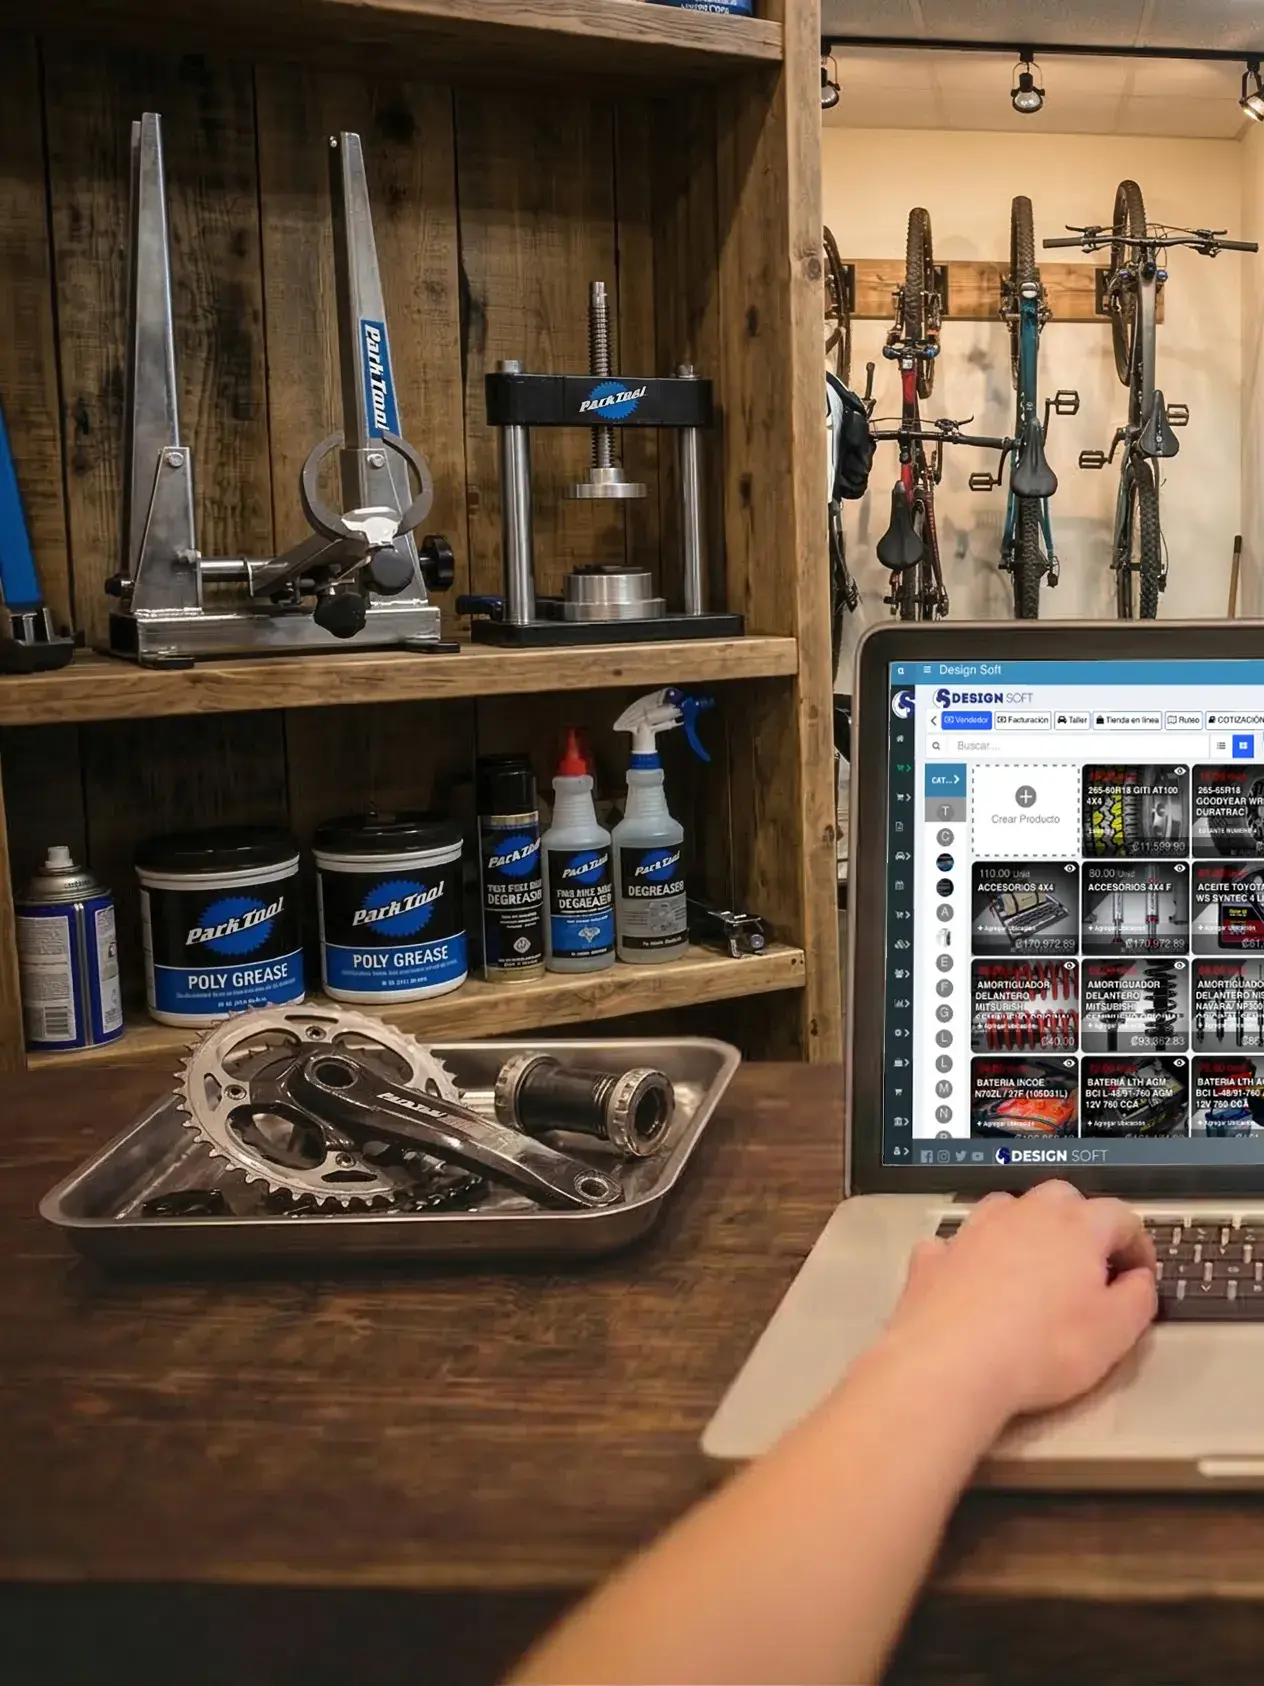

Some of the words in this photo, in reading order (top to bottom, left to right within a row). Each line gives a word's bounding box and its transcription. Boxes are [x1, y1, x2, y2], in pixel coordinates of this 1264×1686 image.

[939, 664, 977, 677] Design
[980, 664, 1002, 675] Soft
[952, 692, 1004, 704] DESIGN
[1005, 692, 1034, 704] SOFT
[955, 716, 989, 724] Vendedor
[1008, 715, 1049, 724] Facturación
[1069, 716, 1087, 724] Taller
[1106, 716, 1130, 724] Tienda
[957, 741, 990, 751] Buscar
[1088, 786, 1132, 794] 265-60R18
[1152, 786, 1178, 794] AT100
[1196, 797, 1247, 805] GOODYEAR
[1196, 808, 1245, 816] DURATRAC
[991, 814, 1017, 824] Crear
[1019, 814, 1061, 824] Producto
[979, 869, 1010, 878] 110.00
[1088, 869, 1115, 878] 80.00
[977, 883, 1036, 892] ACCESORIOS
[1037, 883, 1054, 892] 4X4
[1088, 883, 1147, 892] ACCESORIOS
[1148, 883, 1165, 892] 4X4
[1198, 883, 1229, 892] ACEITE
[1196, 894, 1211, 902] WS
[1212, 894, 1248, 902] SYNTEC
[352, 901, 401, 926] Park
[185, 918, 240, 946] Park
[353, 953, 390, 969] POLY
[393, 945, 449, 966] GREASE
[188, 973, 228, 990] POLY
[232, 963, 288, 988] GREASE
[977, 981, 1050, 989] AMORTIGUADOR
[1087, 981, 1161, 989] AMORTIGUADOR
[975, 992, 1030, 1000] DELANTERO
[1086, 992, 1140, 1000] DELANTERO
[1196, 991, 1250, 999] DELANTERO
[976, 1078, 1015, 1087] BATERIA
[1016, 1078, 1045, 1087] INCOE
[1087, 1078, 1125, 1086] BATERIA
[1127, 1078, 1144, 1086] LTH
[1146, 1078, 1166, 1086] AGM
[1197, 1078, 1235, 1086] BATERIA
[1236, 1078, 1254, 1086] LTH
[974, 1090, 1002, 1098] N70ZL
[1085, 1089, 1101, 1097] BCI
[1152, 1089, 1173, 1097] AGM
[1196, 1089, 1211, 1097] BCI
[1085, 1100, 1101, 1108] 12V
[1120, 1100, 1139, 1108] CCA
[1196, 1100, 1212, 1108] 12V
[1230, 1100, 1249, 1108] CCA
[1011, 1150, 1068, 1162] DESIGN
[1071, 1150, 1108, 1162] SOFT
